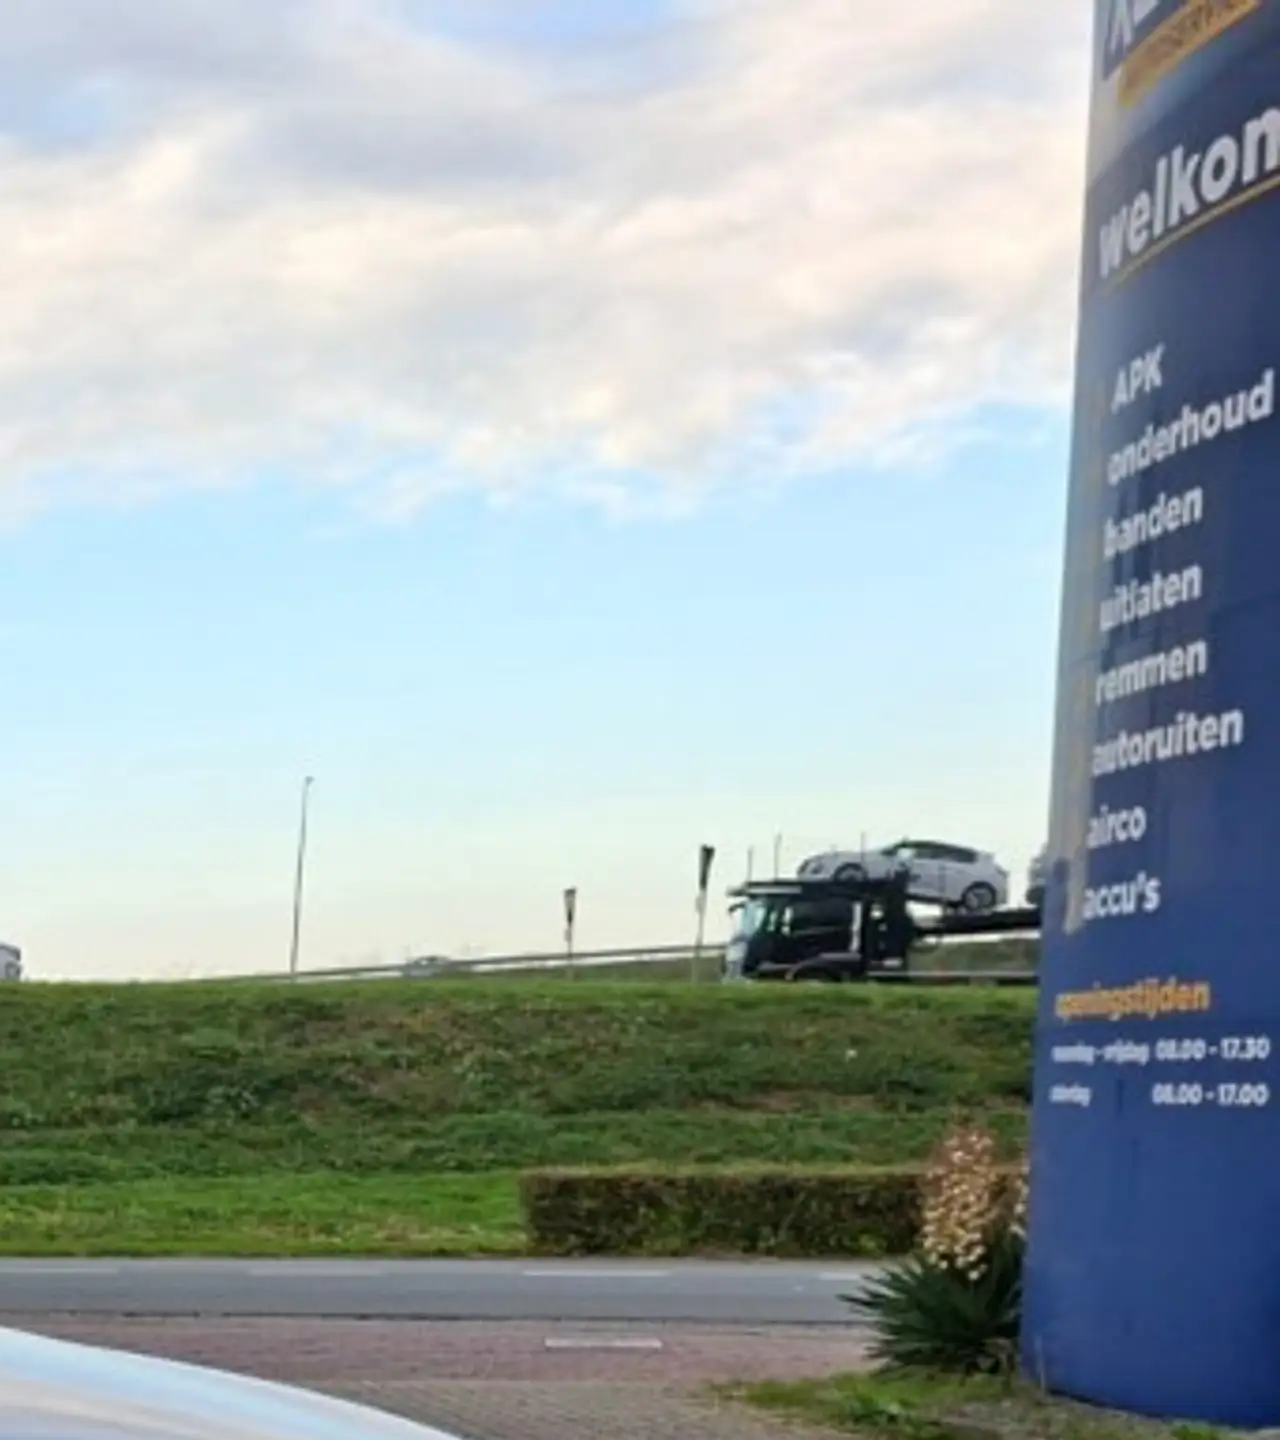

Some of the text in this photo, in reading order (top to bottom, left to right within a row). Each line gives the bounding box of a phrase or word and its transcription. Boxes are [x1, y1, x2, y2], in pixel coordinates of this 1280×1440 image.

[1111, 343, 1165, 414] APK
[1107, 367, 1274, 486] onderhoud
[1104, 486, 1203, 560] banden
[1095, 638, 1208, 705] remmen
[1092, 708, 1244, 776] autoruiten
[1086, 804, 1147, 850] airco
[1083, 870, 1161, 920] accu's
[1220, 1035, 1271, 1060] 17.30
[1217, 1082, 1270, 1107] 17.00
